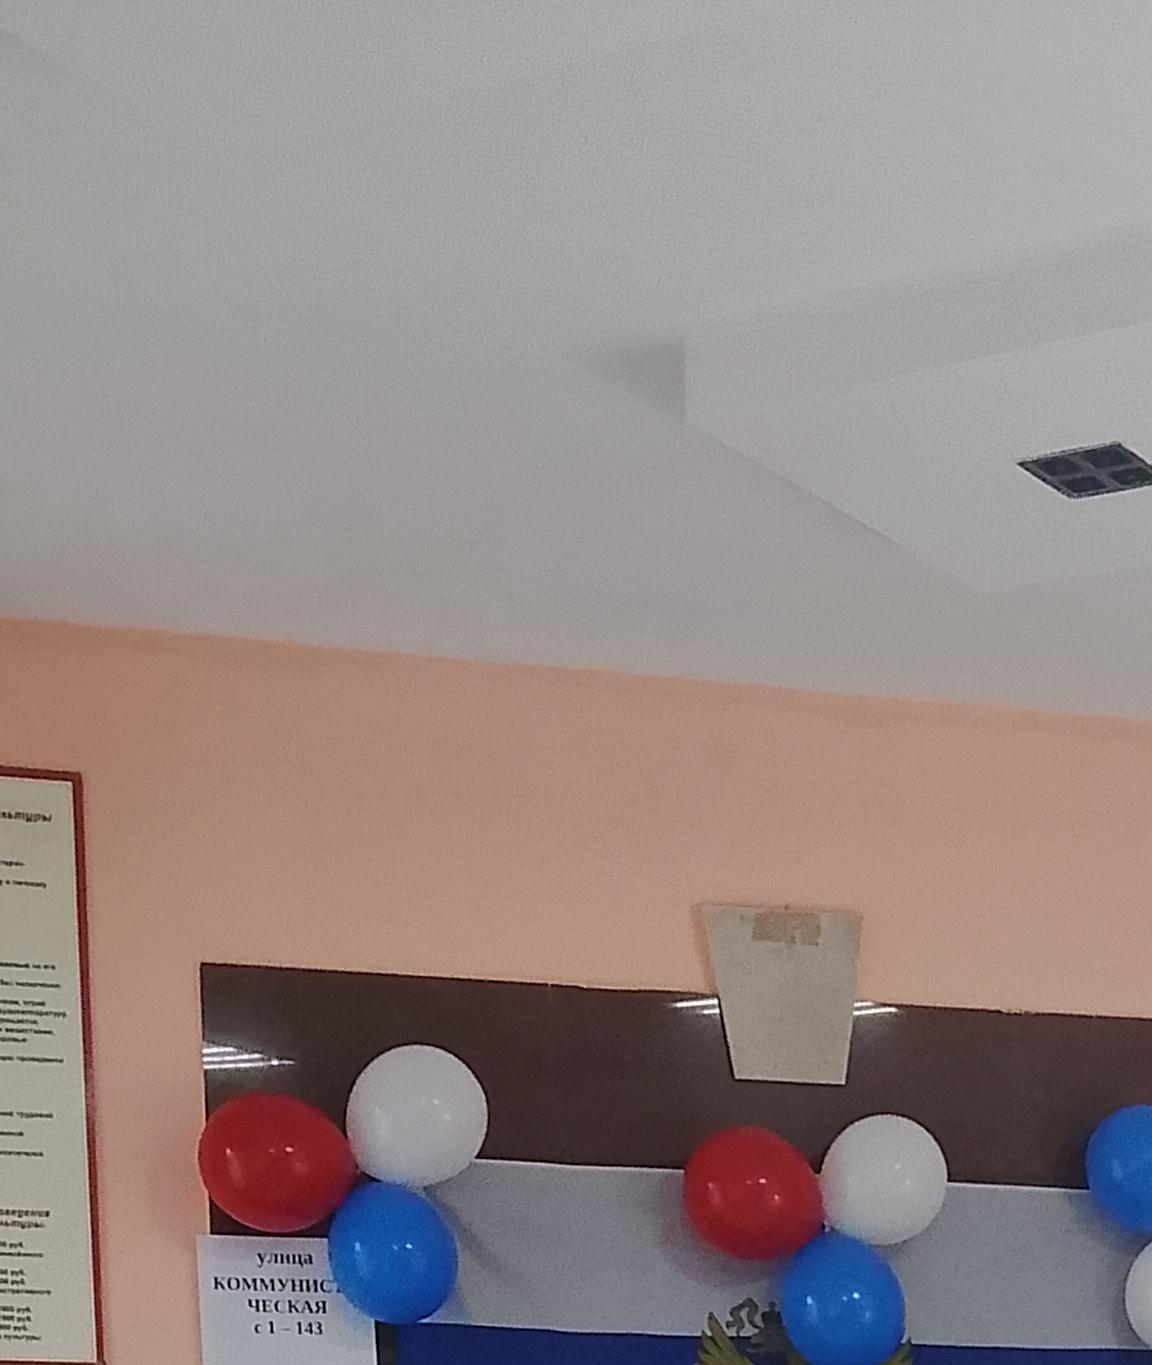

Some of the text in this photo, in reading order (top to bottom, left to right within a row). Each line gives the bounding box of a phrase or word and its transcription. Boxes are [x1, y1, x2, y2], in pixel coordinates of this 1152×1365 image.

[256, 1252, 314, 1269] улица
[247, 1298, 328, 1314] ЧЕСКАЯ
[254, 1323, 262, 1334] с
[268, 1320, 275, 1334] 1
[297, 1320, 323, 1335] 143
